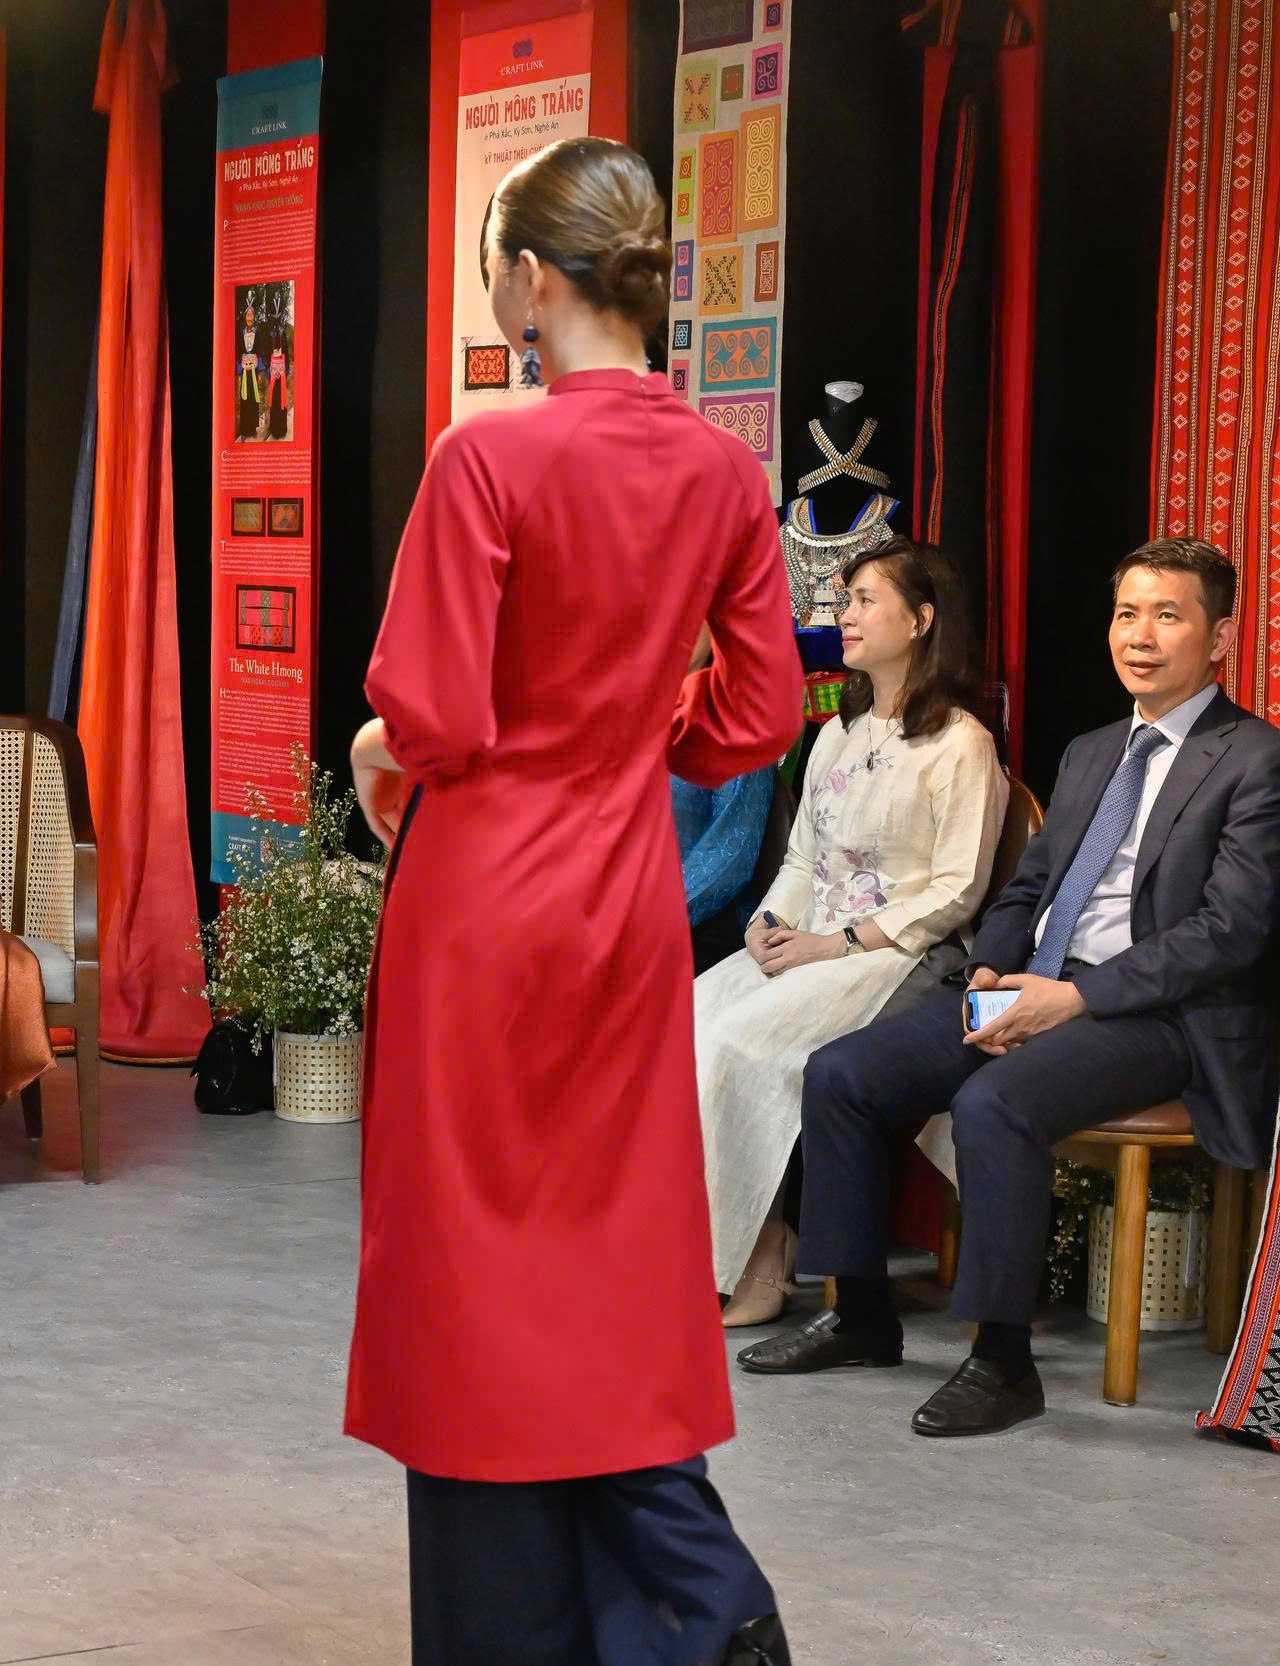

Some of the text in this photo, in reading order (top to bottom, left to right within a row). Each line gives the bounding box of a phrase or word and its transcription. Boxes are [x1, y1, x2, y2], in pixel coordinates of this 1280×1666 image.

[500, 60, 544, 76] CRAFT LINK
[465, 79, 584, 130] NGƯỜI MÔNG TRẮNG
[251, 123, 272, 136] CRAFT
[550, 121, 559, 130] An
[224, 138, 315, 182] NGƯỜI MÔNG TRẮNG
[493, 149, 513, 165] THUẬT
[513, 146, 528, 161] THÊU
[229, 657, 244, 673] The
[245, 659, 270, 675] White
[271, 661, 303, 684] Hmong
